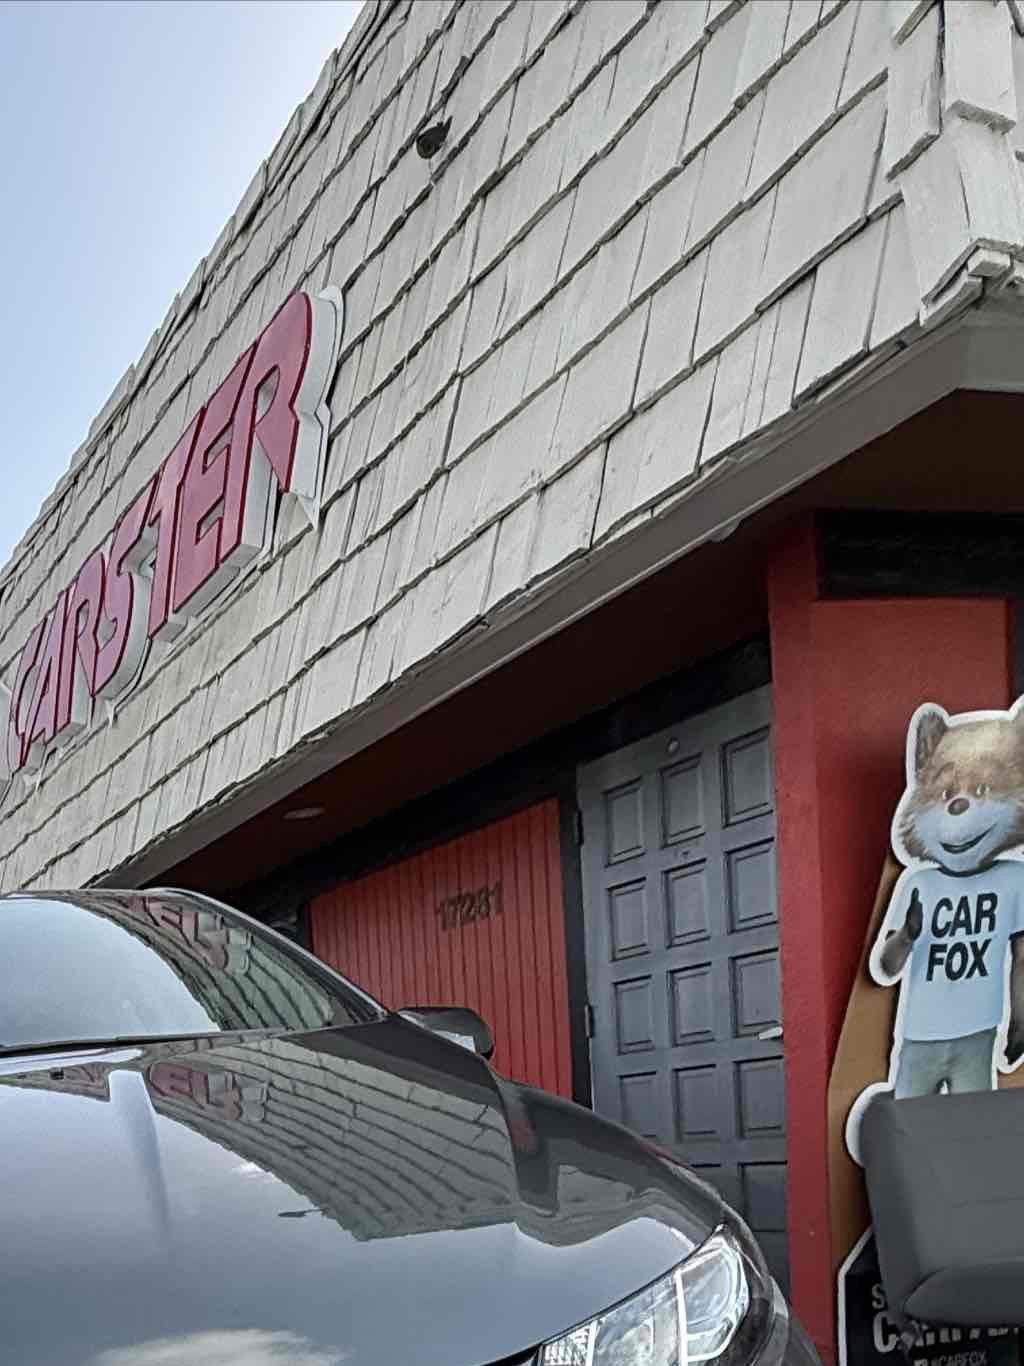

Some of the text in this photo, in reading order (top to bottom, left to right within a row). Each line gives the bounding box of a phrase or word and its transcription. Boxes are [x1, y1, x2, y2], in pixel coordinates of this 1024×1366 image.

[12, 288, 336, 769] CARSTER
[931, 892, 998, 938] CAR
[926, 938, 992, 982] FOX
